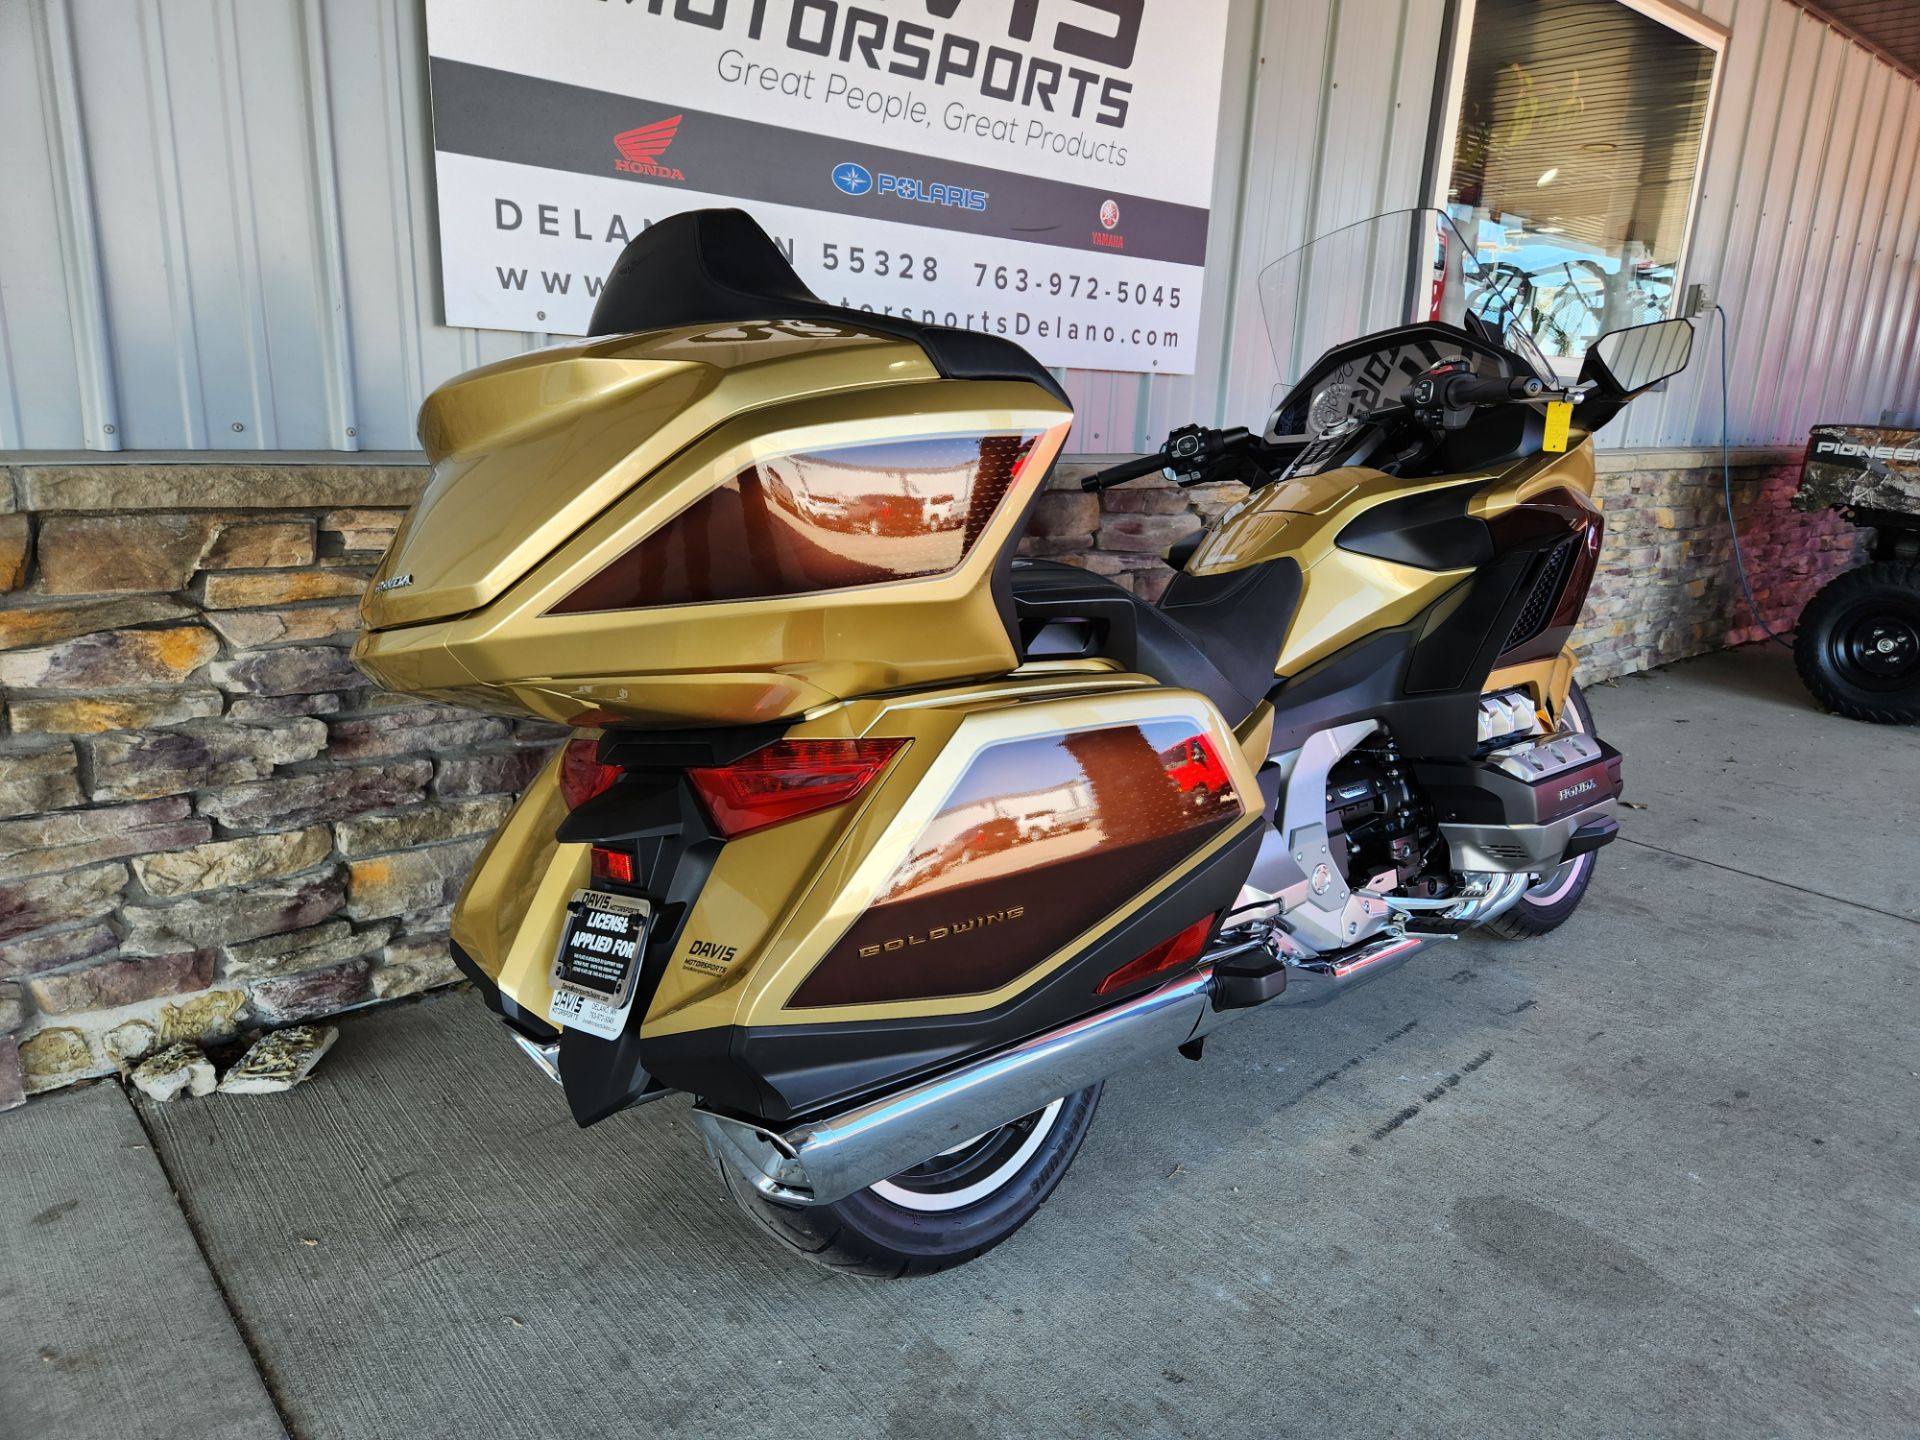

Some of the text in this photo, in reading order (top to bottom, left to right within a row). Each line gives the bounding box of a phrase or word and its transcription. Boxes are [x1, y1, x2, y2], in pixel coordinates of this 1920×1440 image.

[600, 0, 1133, 129] OTORSPORTS
[718, 50, 1128, 166] Great People, Great Products
[614, 159, 687, 181] HONDA
[877, 173, 986, 212] POLARIS
[1092, 231, 1125, 249] YAMAHA
[822, 243, 938, 282] 55328
[974, 263, 1182, 309] 763-972-5045
[581, 892, 612, 910] DAVIS
[586, 911, 629, 934] LICENSE
[858, 906, 1025, 958] GOLDWING
[570, 931, 636, 958] APPLIED FOR
[689, 940, 738, 961] DAVIS
[684, 958, 727, 973] MOTORSPORTS
[553, 991, 585, 1013] DAVIS
